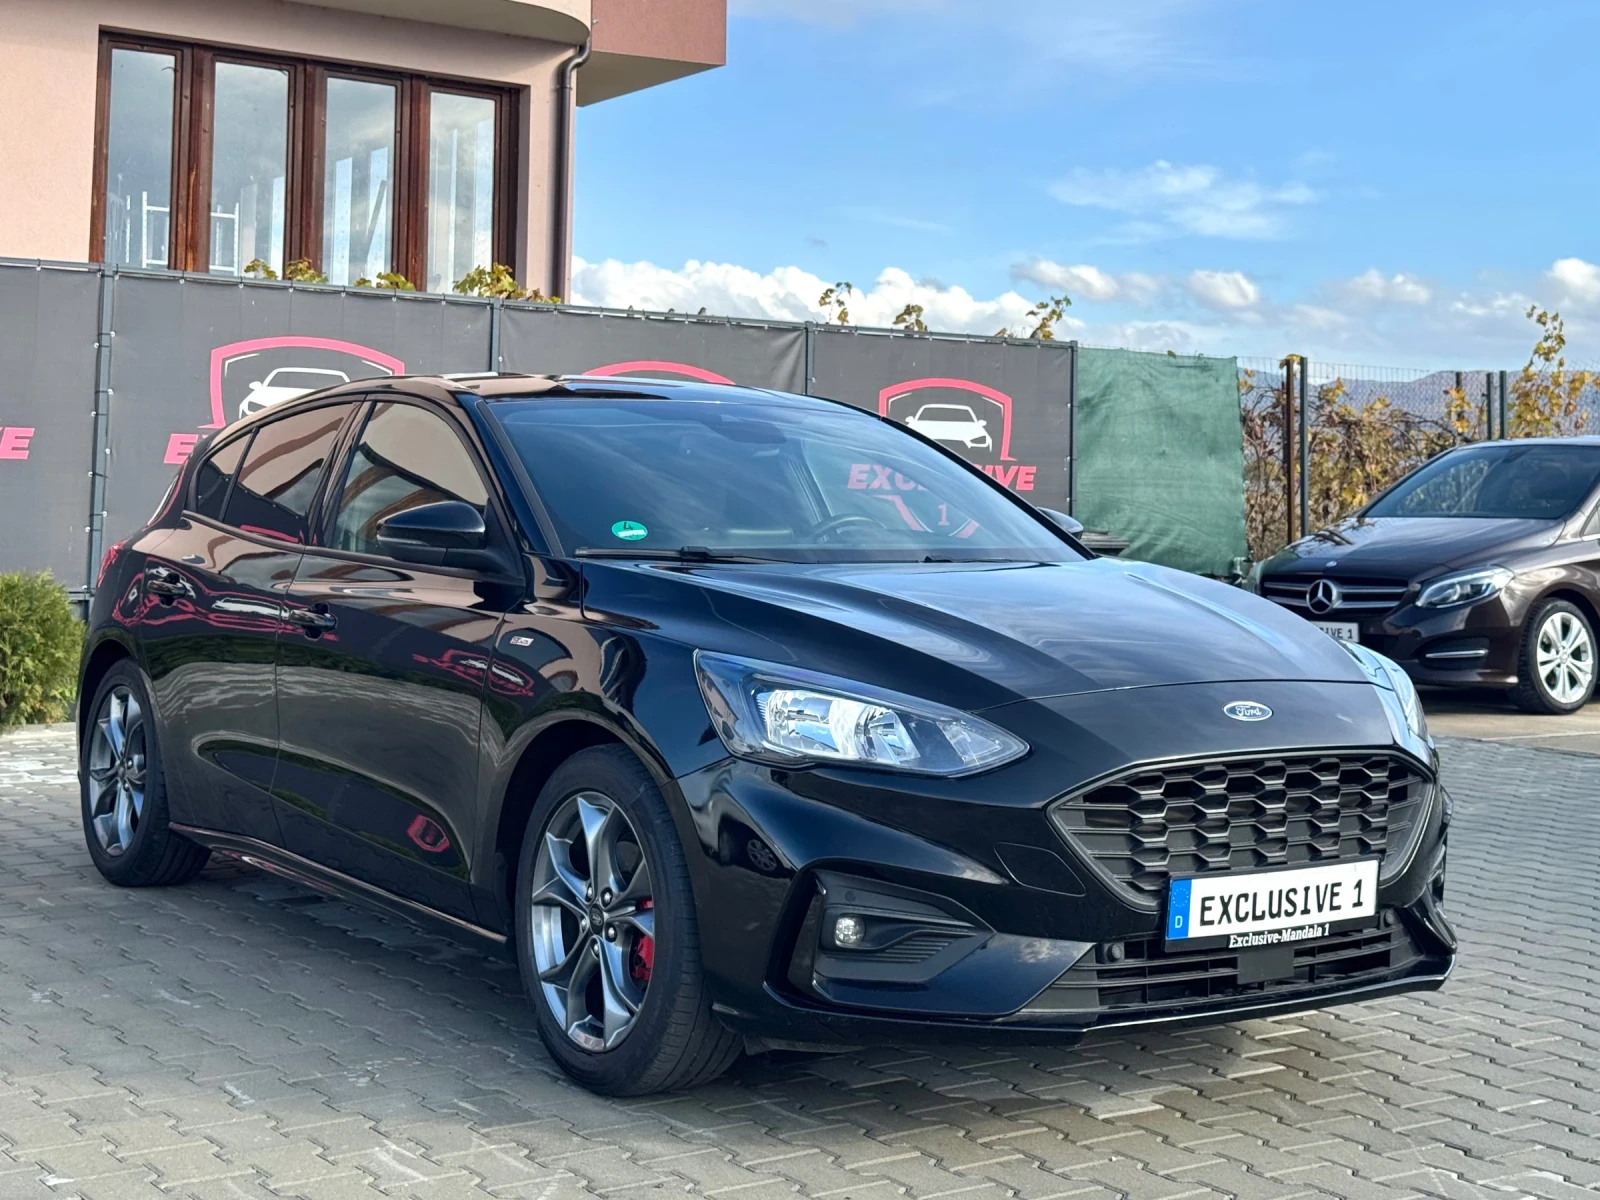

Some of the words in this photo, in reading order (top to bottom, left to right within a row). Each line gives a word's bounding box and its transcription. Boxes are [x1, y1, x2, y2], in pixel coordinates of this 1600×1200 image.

[937, 504, 949, 526] 1
[1347, 628, 1353, 639] 1
[1235, 705, 1262, 716] Ford
[1200, 882, 1342, 927] EXCLUSIVE
[1352, 879, 1363, 908] 1
[1175, 915, 1183, 928] D
